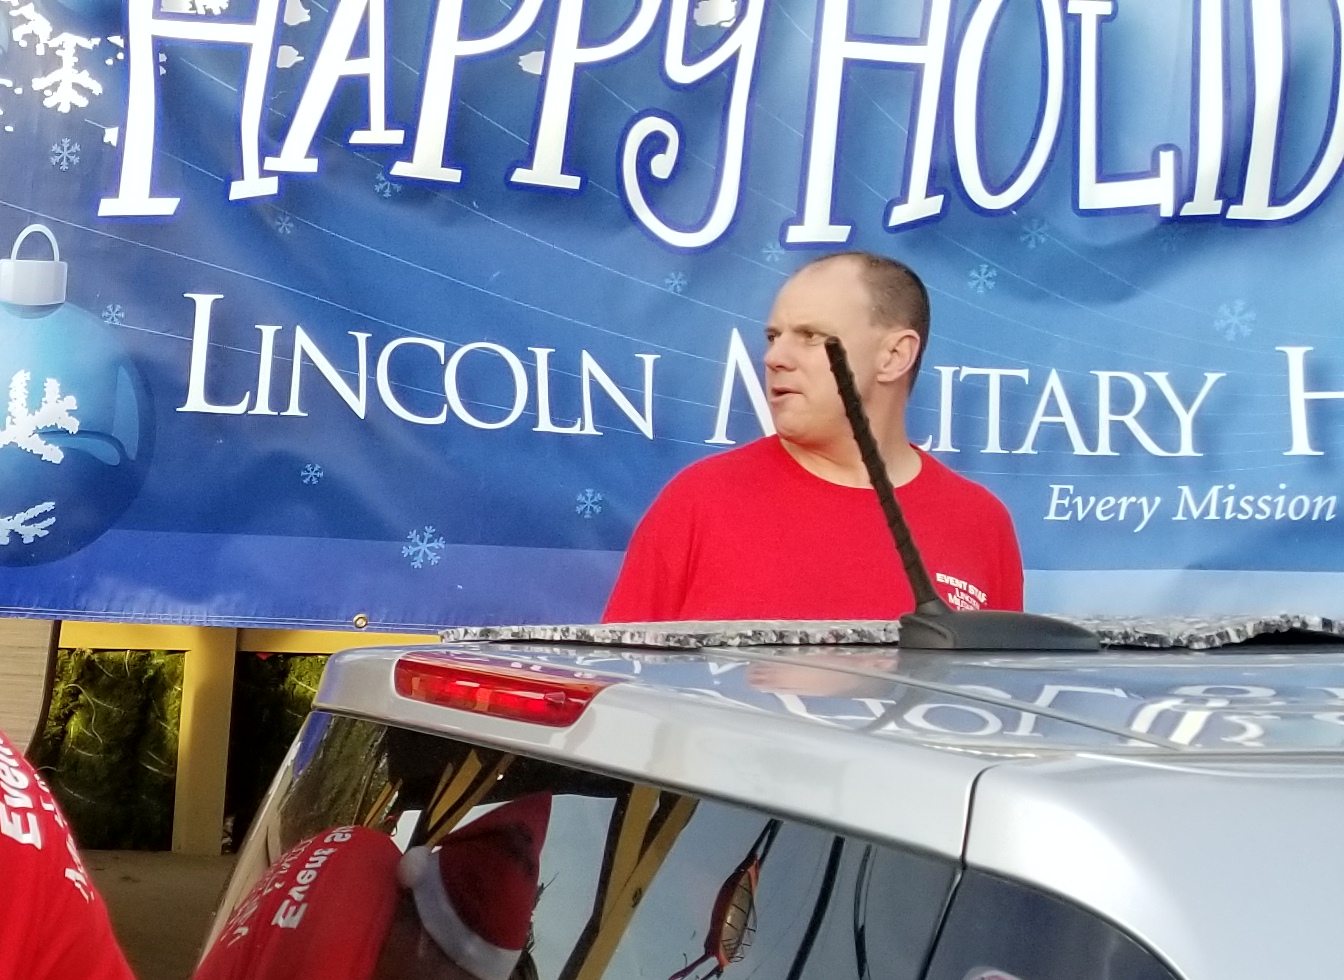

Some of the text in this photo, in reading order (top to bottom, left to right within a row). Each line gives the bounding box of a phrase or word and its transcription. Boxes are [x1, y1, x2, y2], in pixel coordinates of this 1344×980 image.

[176, 293, 661, 440] LINCOLN
[704, 327, 1227, 457] MITARY
[1043, 483, 1337, 533] Every Mission
[935, 573, 968, 590] EVENT
